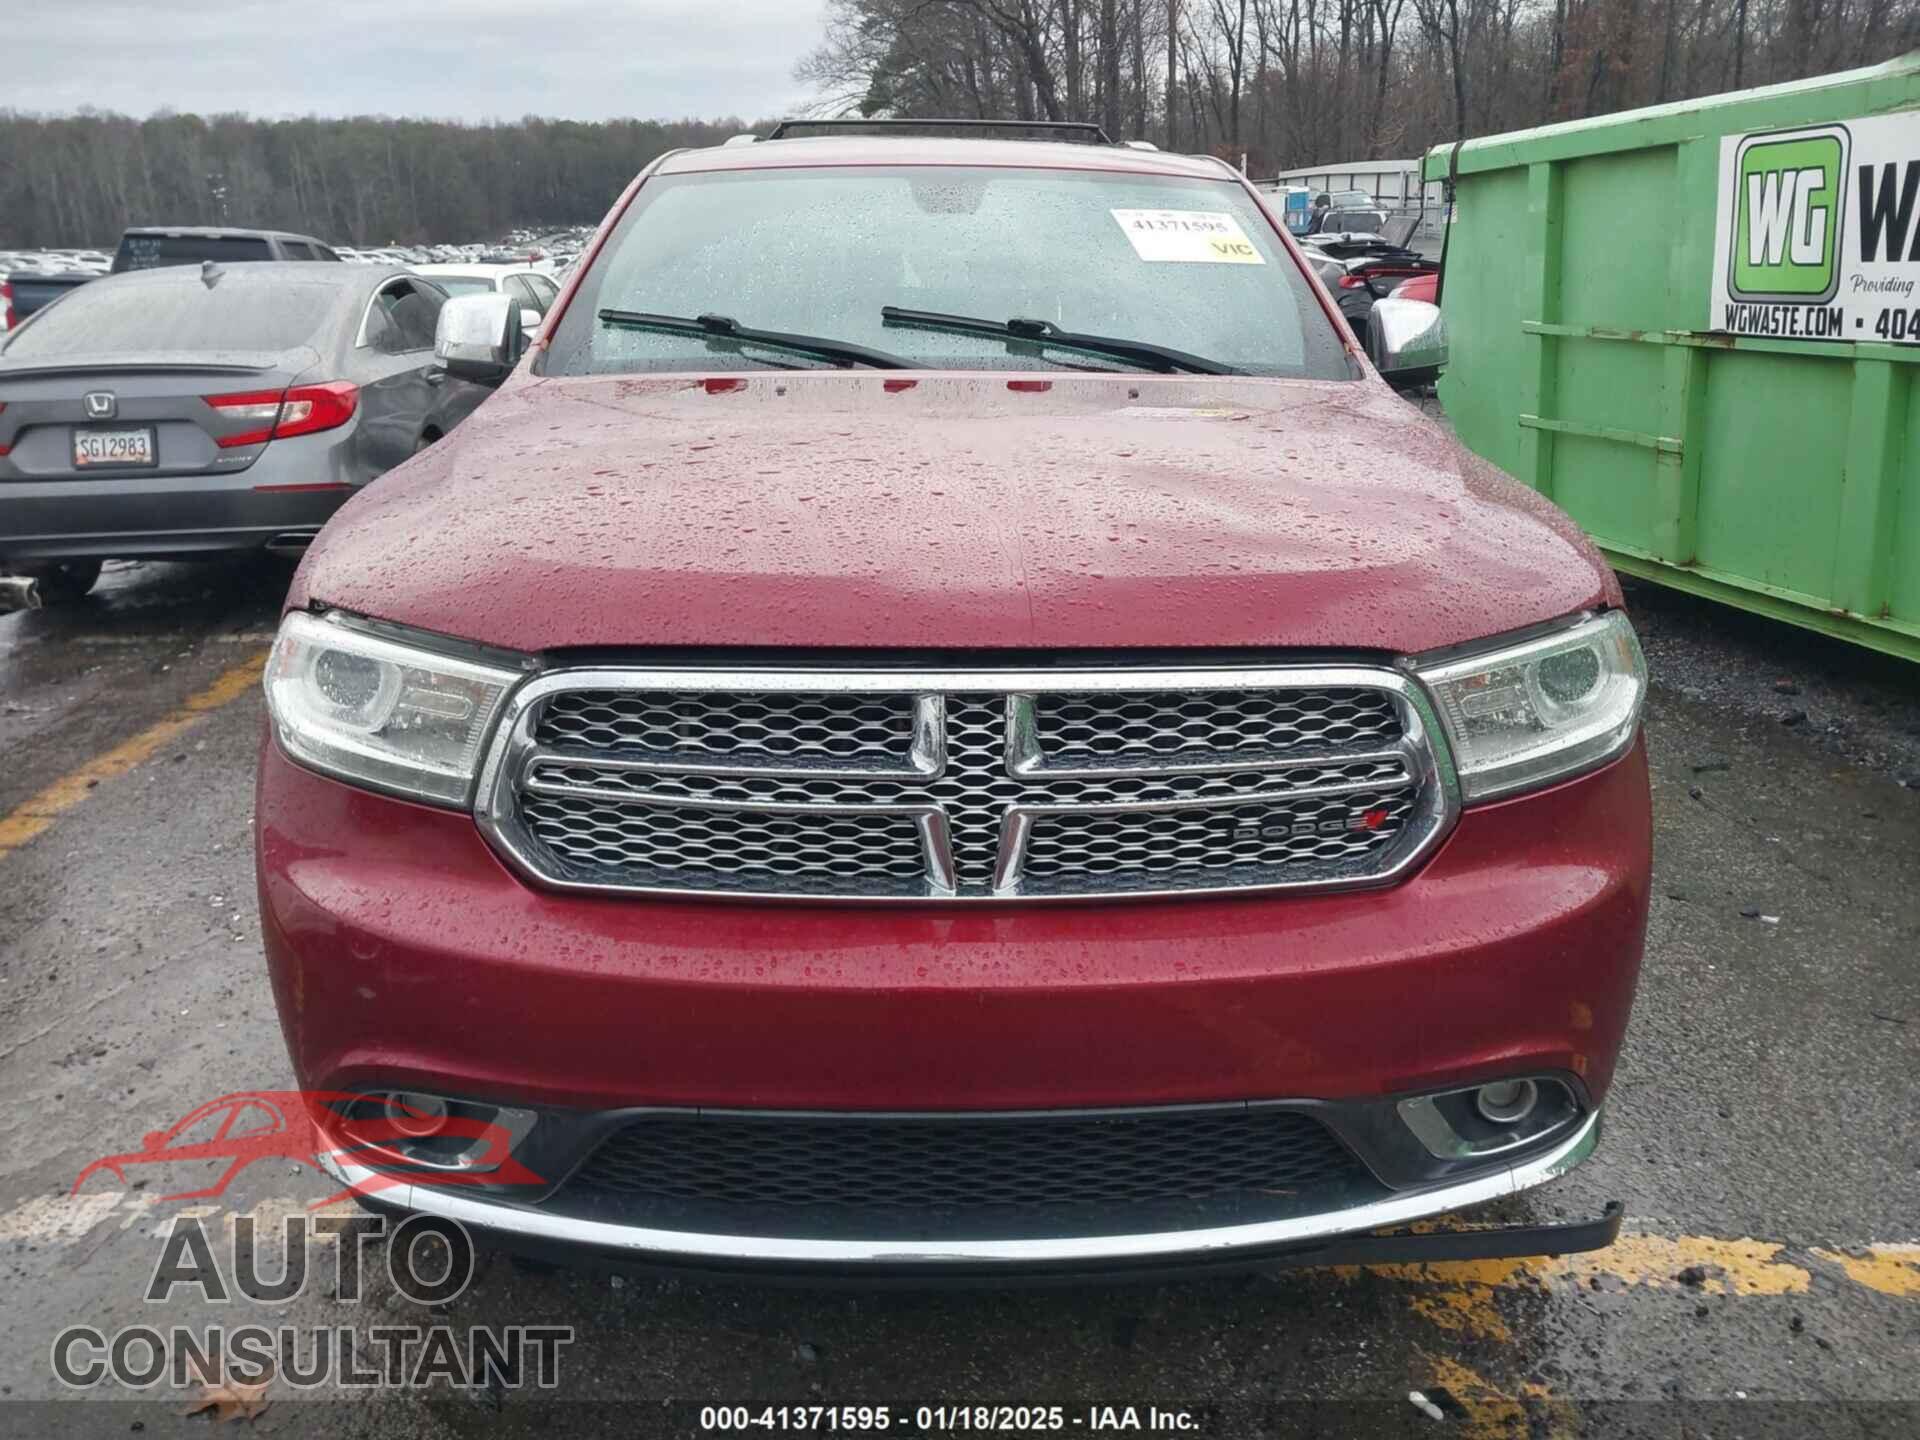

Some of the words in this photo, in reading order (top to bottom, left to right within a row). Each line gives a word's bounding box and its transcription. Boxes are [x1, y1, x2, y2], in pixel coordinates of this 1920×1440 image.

[1747, 165, 1829, 267] WG
[1858, 159, 1920, 262] W
[1132, 219, 1229, 233] 41371595
[1850, 274, 1915, 298] Providing
[1725, 304, 1844, 336] WGWASTE.COM
[1232, 817, 1369, 839] DODGE
